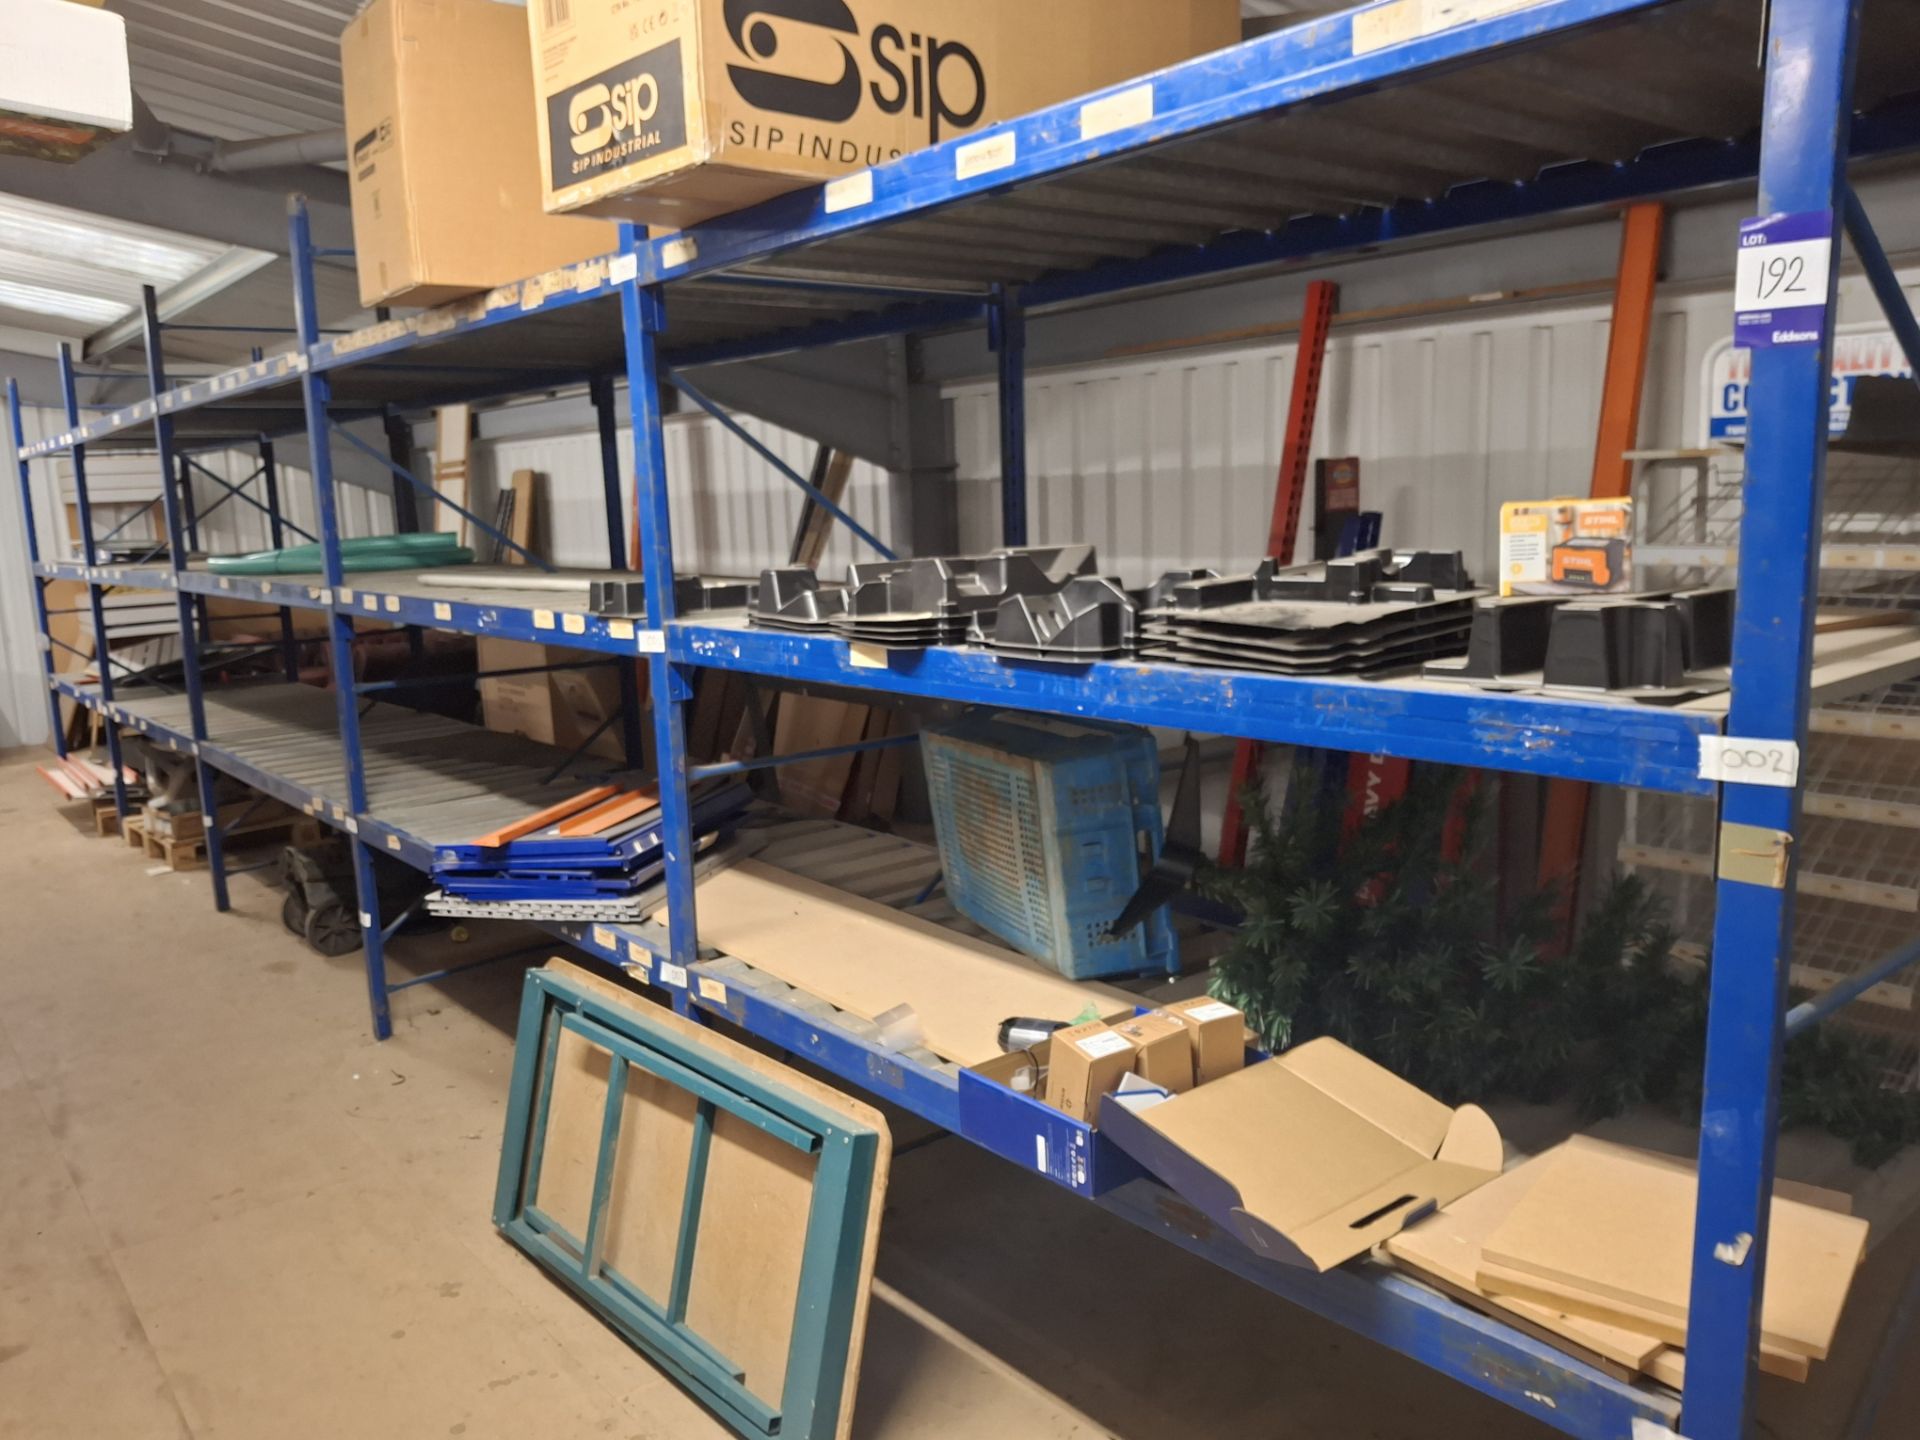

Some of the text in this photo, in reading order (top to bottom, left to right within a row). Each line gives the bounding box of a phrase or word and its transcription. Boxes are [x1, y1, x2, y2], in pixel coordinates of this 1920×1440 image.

[729, 120, 784, 151] SIP
[571, 130, 662, 175] SIP INDUSTRIAL
[1756, 256, 1807, 300] 192
[1583, 515, 1619, 526] STIHL
[1562, 556, 1594, 567] STIHL
[1719, 748, 1793, 775] 002
